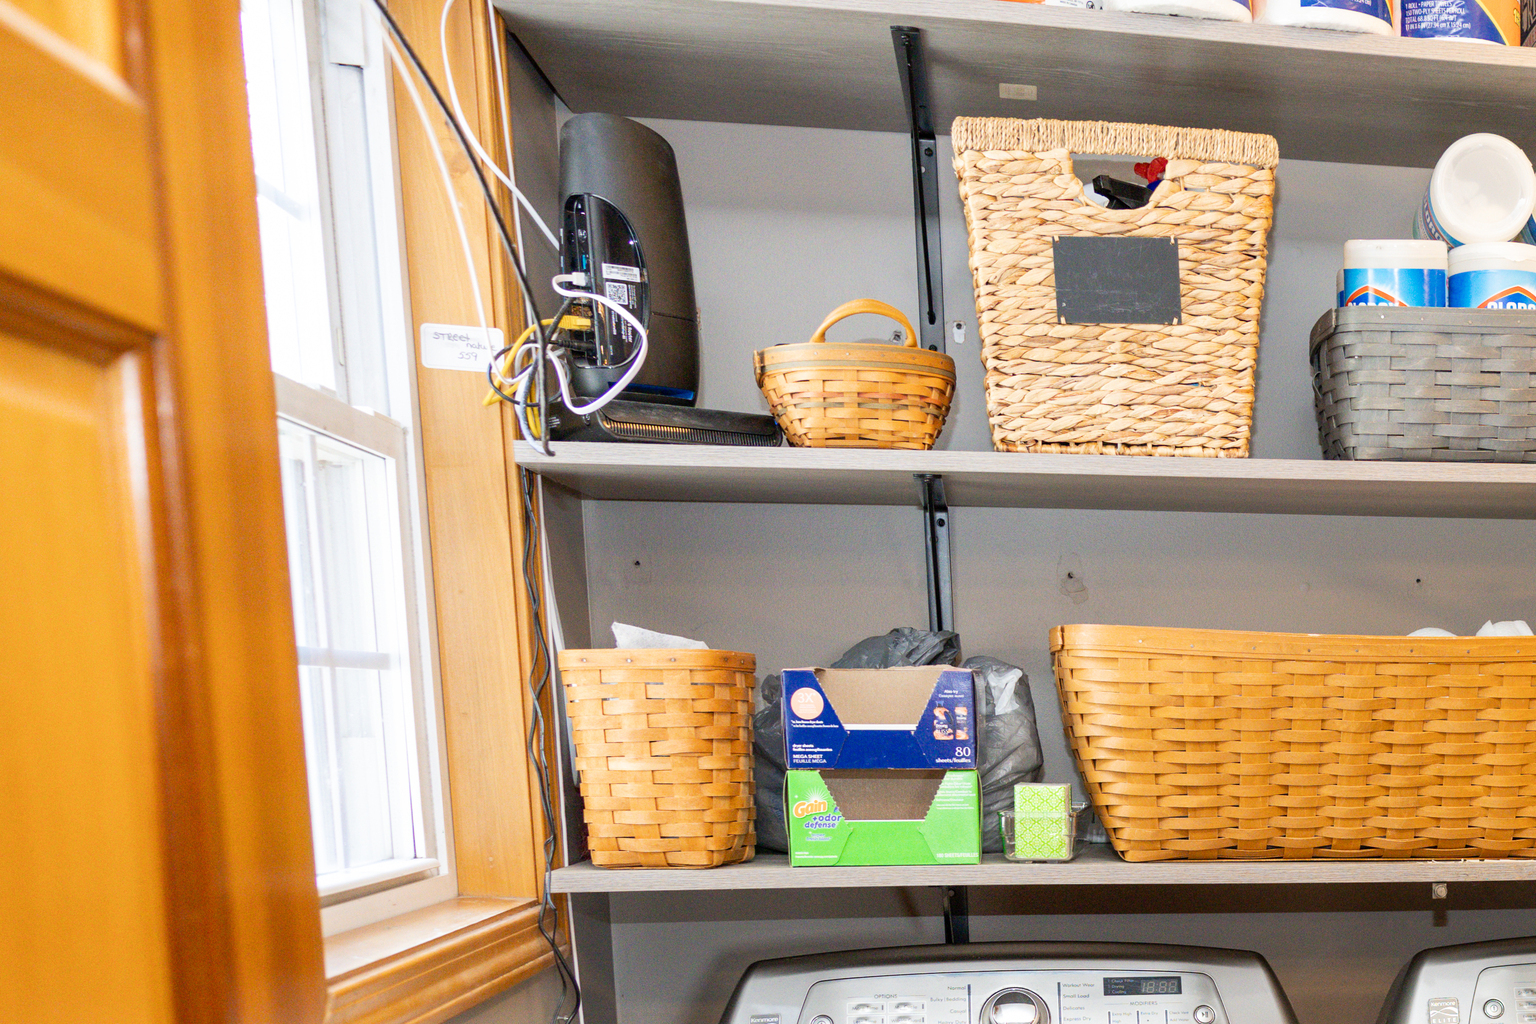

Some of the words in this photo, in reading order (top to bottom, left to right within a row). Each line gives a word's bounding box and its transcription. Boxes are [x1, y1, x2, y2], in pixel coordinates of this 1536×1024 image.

[955, 746, 971, 756] 80
[794, 800, 828, 818] Gain
[804, 821, 836, 829] defense
